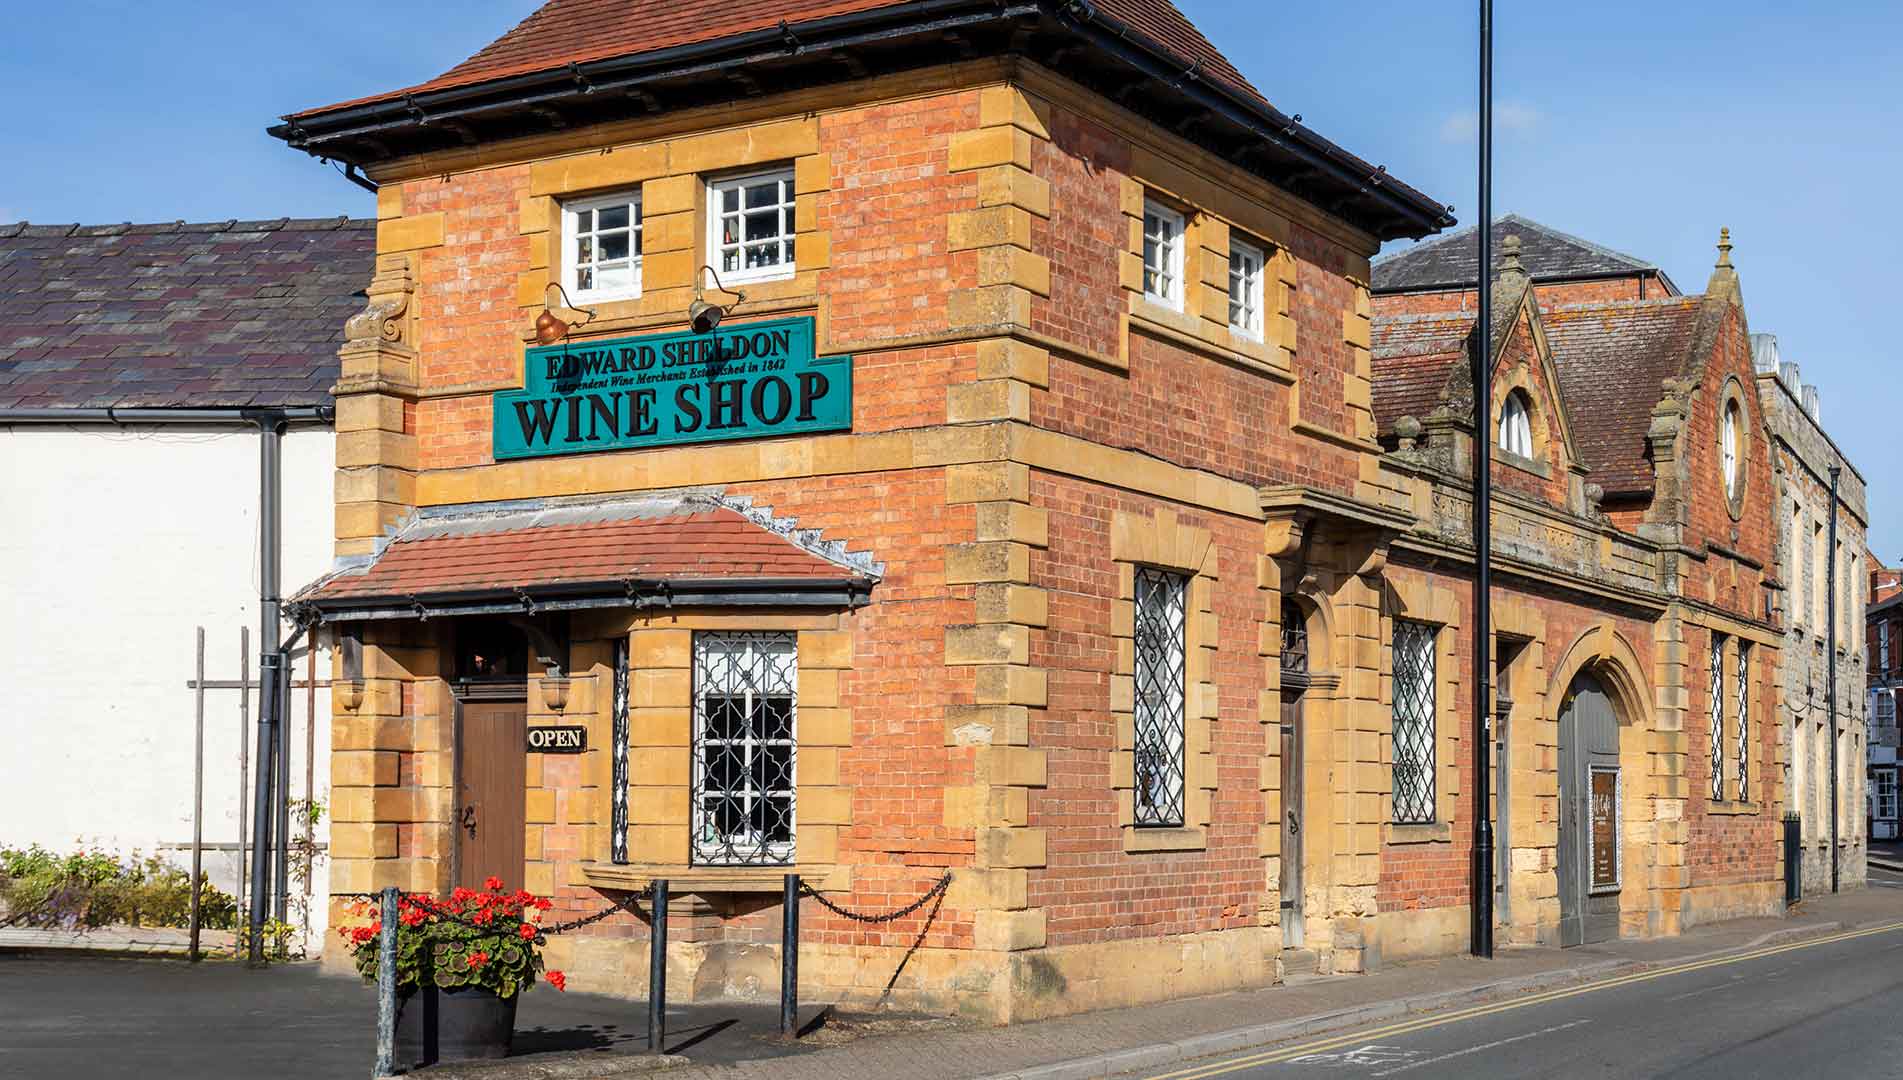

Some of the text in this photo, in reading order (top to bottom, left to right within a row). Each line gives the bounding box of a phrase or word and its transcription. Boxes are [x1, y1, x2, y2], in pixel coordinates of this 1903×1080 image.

[545, 329, 791, 380] EDWARD SHELDON
[551, 379, 609, 393] Inendent
[611, 375, 634, 387] Wine
[636, 370, 686, 385] Merchants
[689, 362, 745, 379] Estshed
[747, 361, 758, 373] in
[511, 371, 830, 448] WINE SHOP
[528, 729, 582, 747] OPEN
